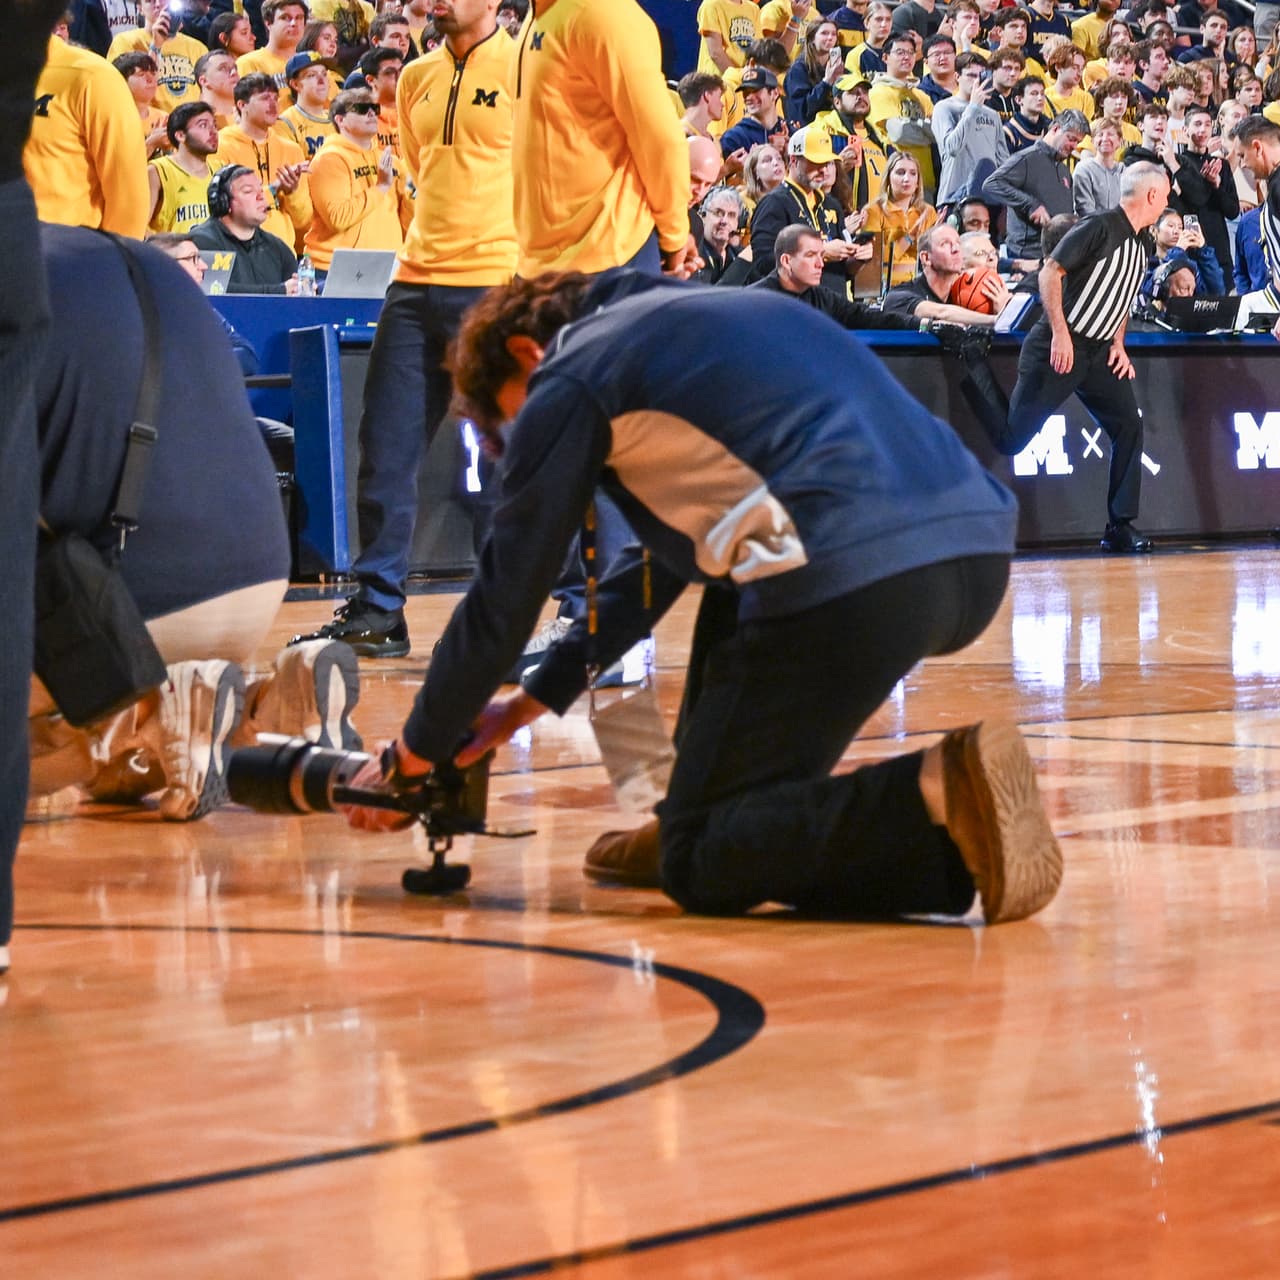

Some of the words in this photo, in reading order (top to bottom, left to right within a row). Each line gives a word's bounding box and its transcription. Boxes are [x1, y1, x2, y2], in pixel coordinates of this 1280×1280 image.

[472, 88, 499, 108] M
[212, 252, 234, 271] M
[1014, 414, 1073, 476] M
